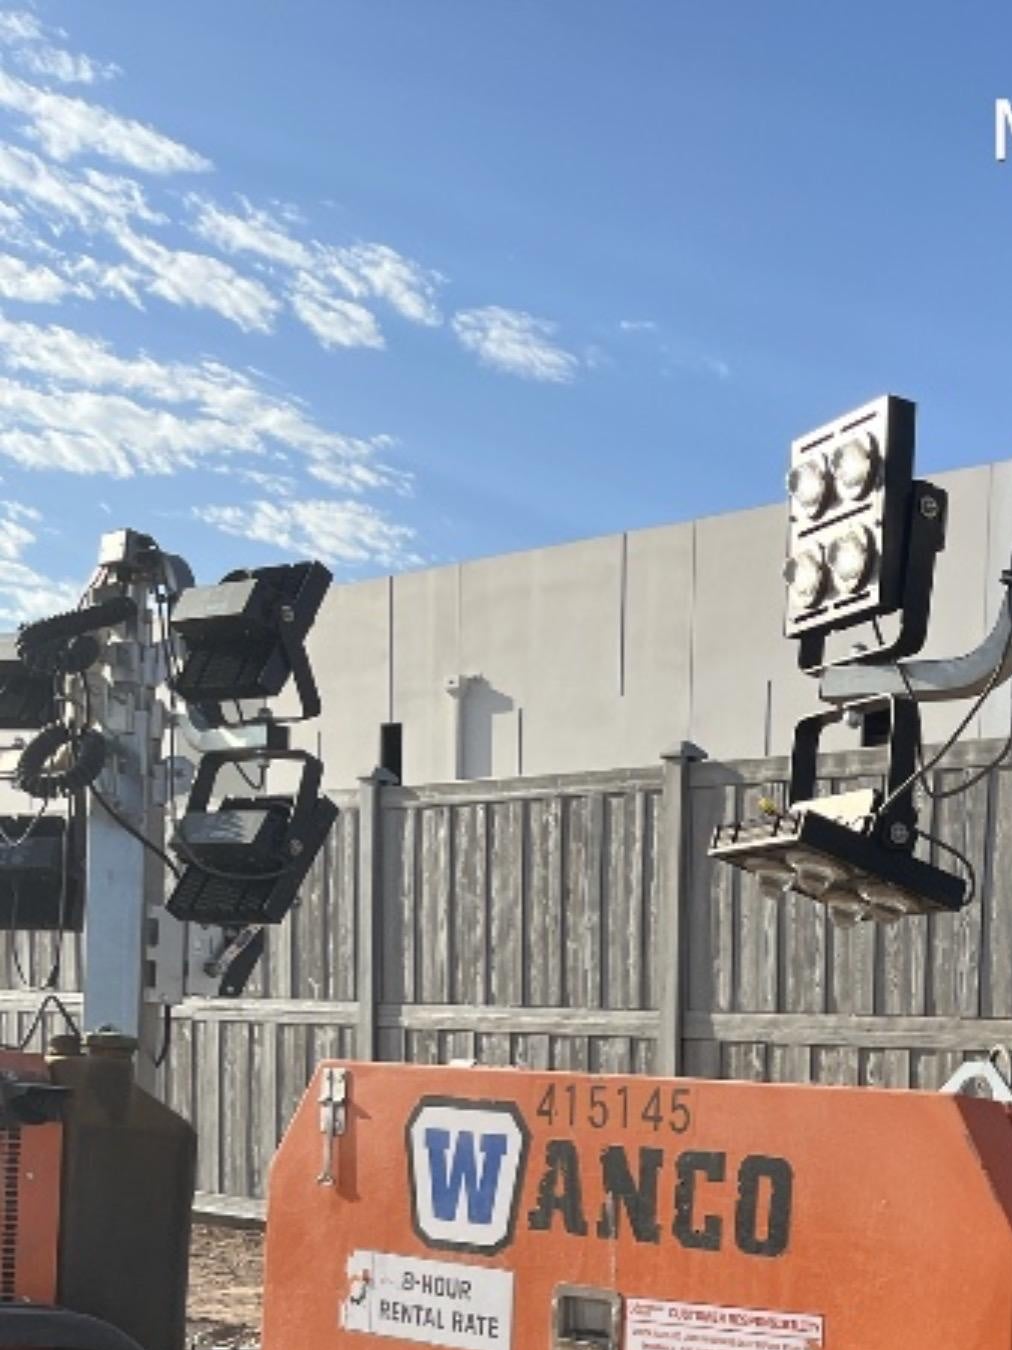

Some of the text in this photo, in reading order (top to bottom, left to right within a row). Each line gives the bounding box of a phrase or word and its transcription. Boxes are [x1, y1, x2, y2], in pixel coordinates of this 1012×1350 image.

[536, 1085, 691, 1134] 415145
[426, 1130, 794, 1258] WANCO
[401, 1271, 472, 1300] 8-HOUR
[379, 1299, 499, 1339] RENTAL RATE
